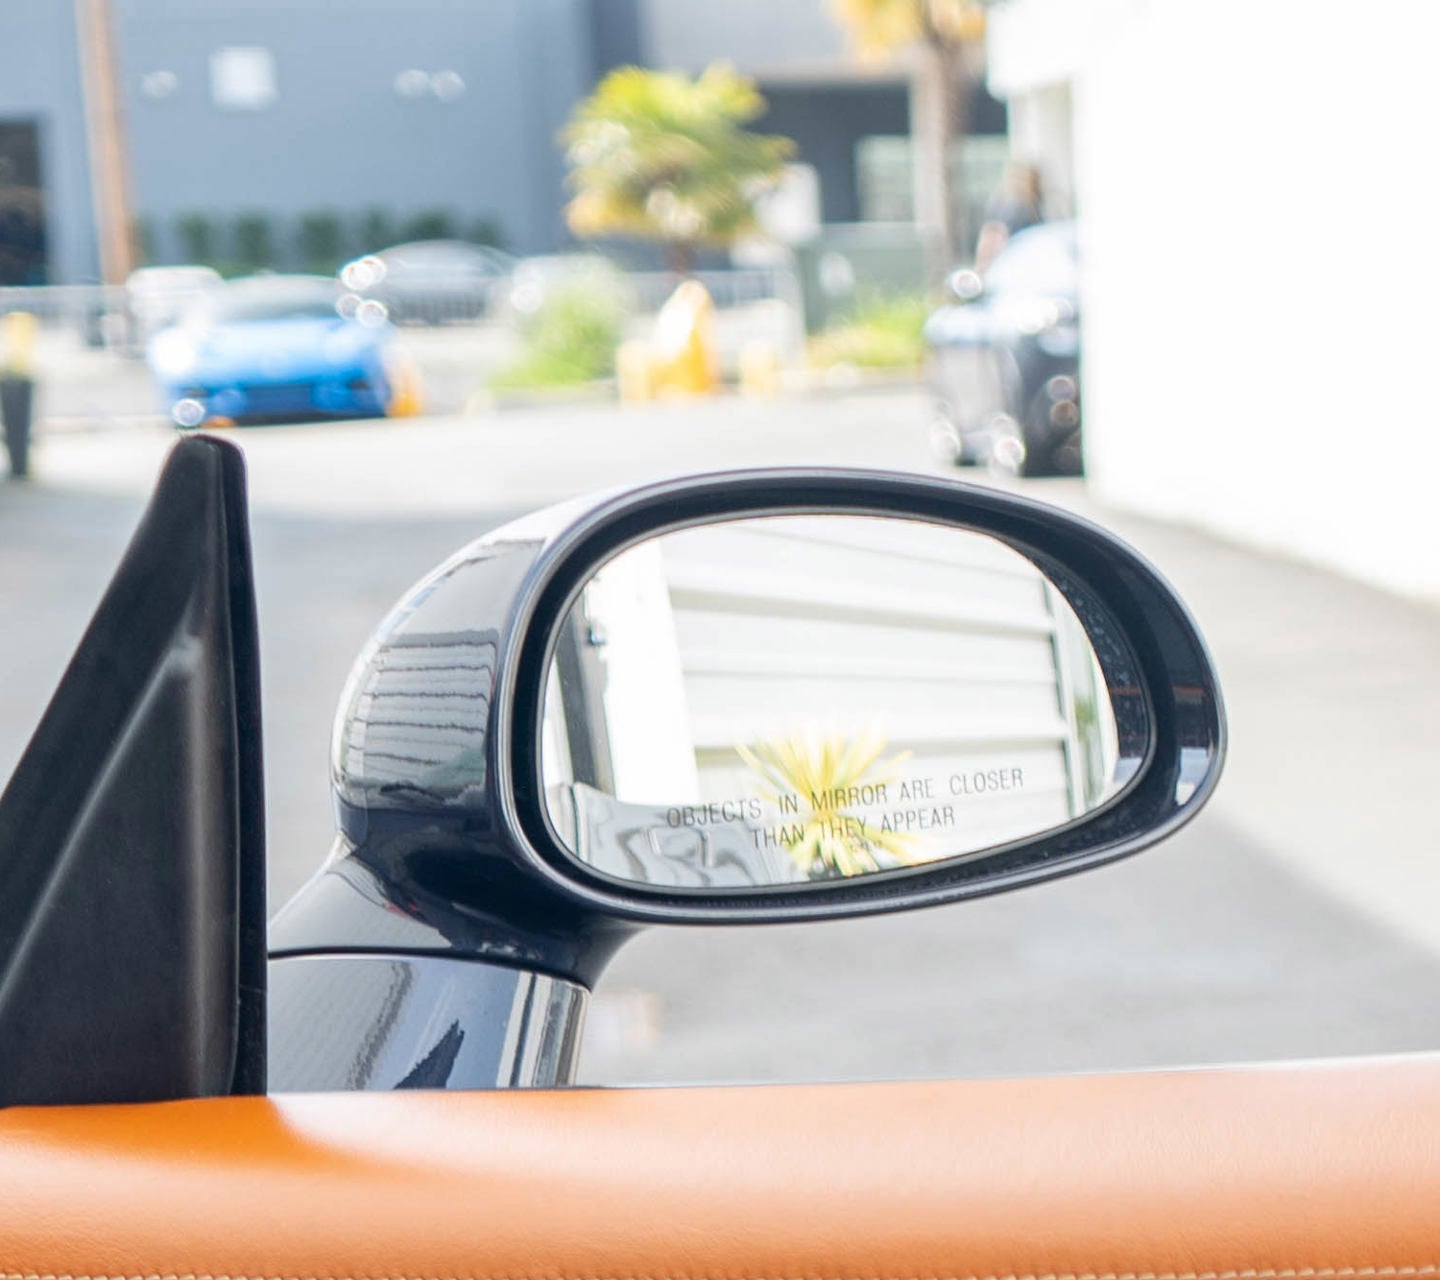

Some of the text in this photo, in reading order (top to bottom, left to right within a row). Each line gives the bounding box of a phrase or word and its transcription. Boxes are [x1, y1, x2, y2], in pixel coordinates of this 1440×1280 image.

[666, 767, 1025, 828] OBJECTS IN MIRROR ARE CLOSER
[752, 805, 956, 849] THAN THEY APPEAR
